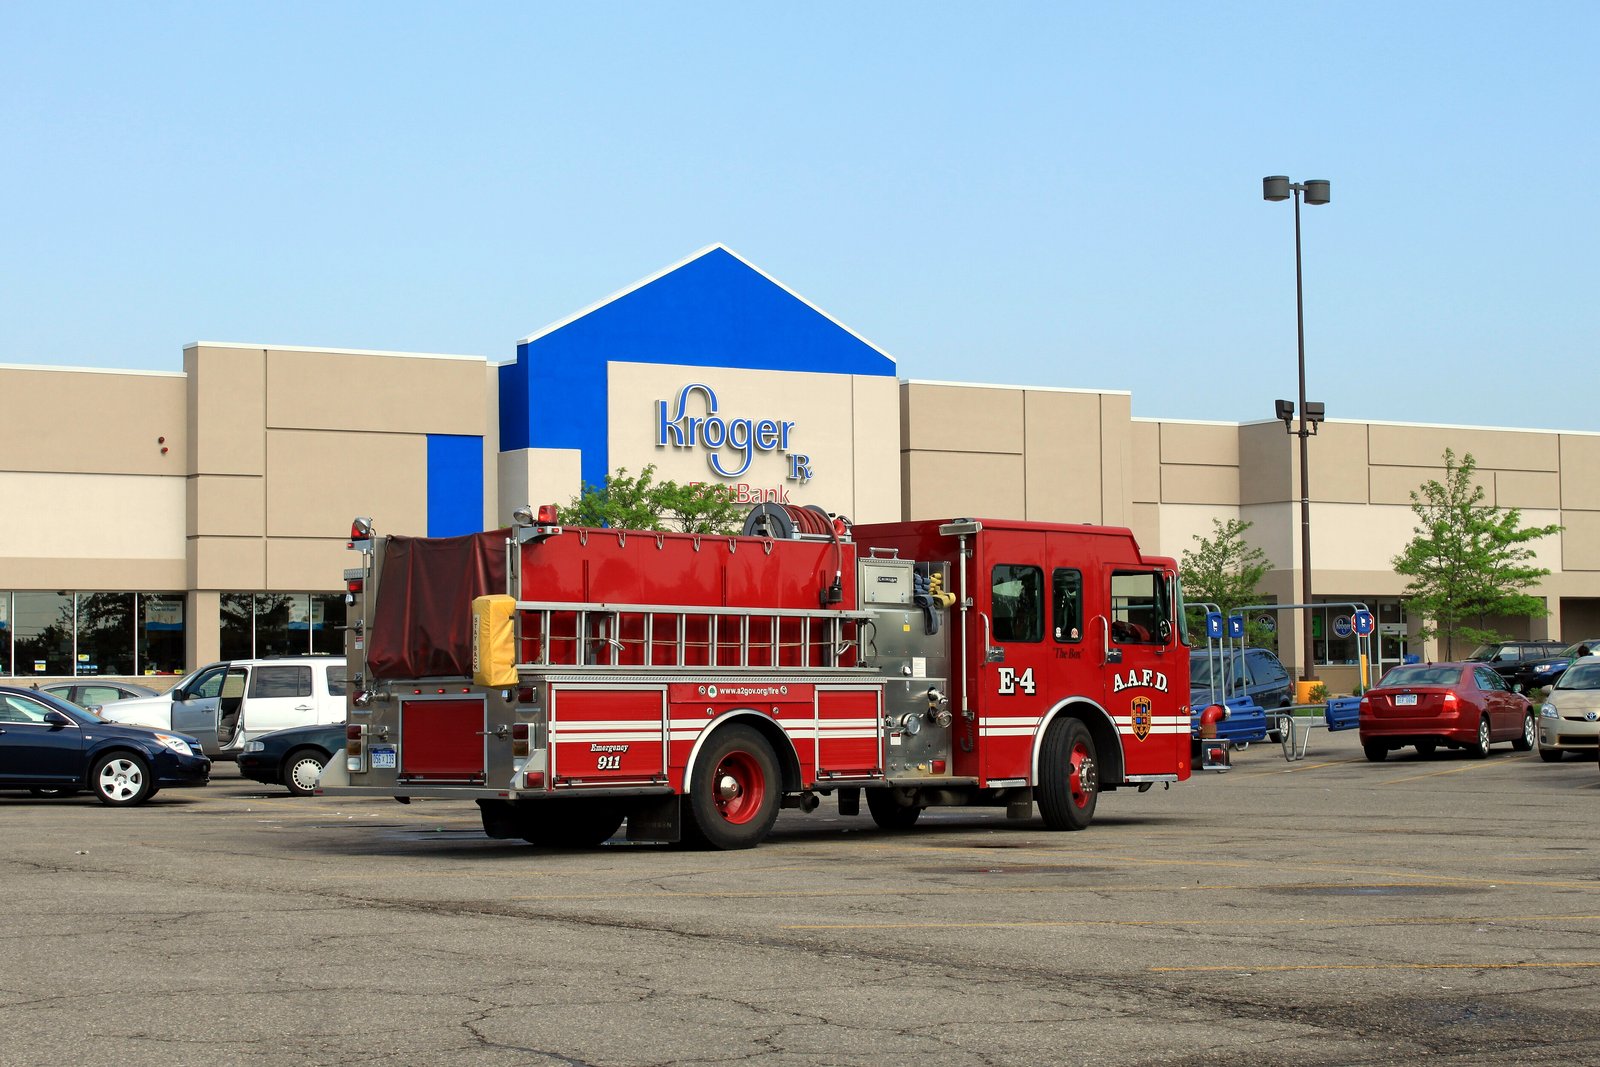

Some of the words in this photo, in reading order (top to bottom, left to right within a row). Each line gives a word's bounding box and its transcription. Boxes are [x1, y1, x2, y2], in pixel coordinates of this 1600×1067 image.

[655, 383, 796, 478] Kroger
[689, 481, 791, 504] tBank
[998, 667, 1036, 694] E-4
[1113, 669, 1168, 693] A.A.F.D.
[590, 743, 629, 753] Emergency
[597, 755, 621, 770] 911
